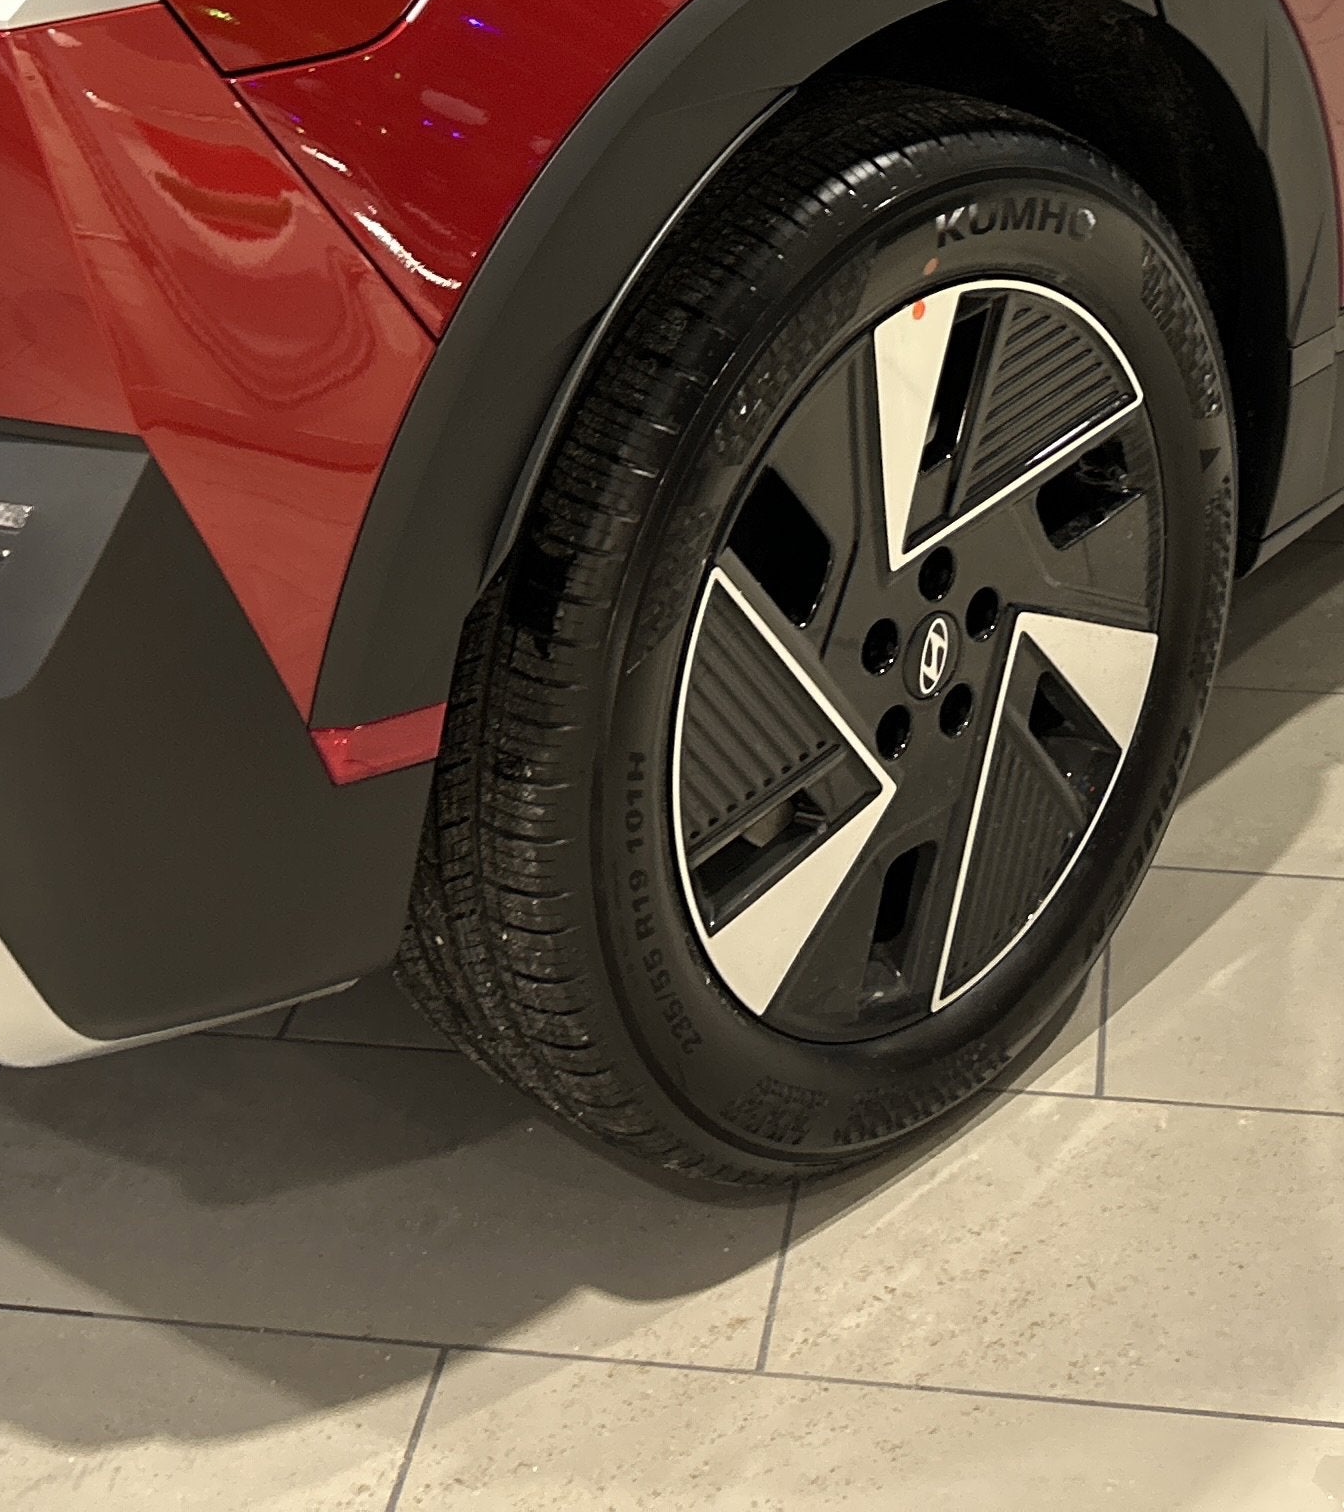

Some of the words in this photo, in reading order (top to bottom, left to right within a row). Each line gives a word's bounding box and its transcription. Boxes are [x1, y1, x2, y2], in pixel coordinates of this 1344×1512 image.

[935, 197, 1097, 248] KUMHO
[628, 868, 656, 941] R19
[643, 947, 703, 1055] 235/55
